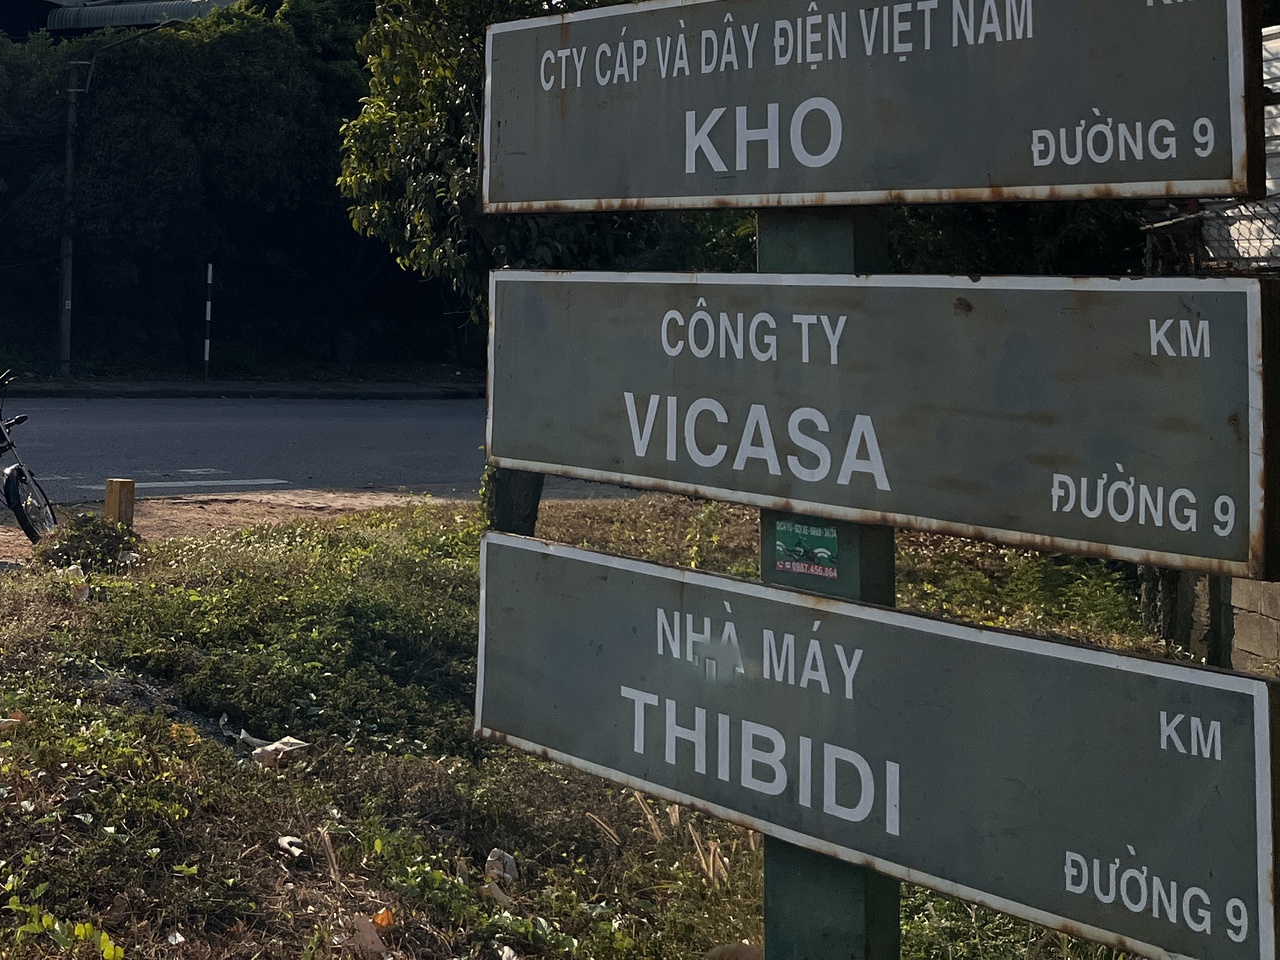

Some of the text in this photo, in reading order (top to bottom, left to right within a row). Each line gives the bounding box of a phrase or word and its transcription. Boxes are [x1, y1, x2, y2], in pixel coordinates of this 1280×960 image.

[540, 47, 586, 90] CTY
[596, 26, 647, 86] CÁP
[656, 19, 690, 78] VÀ
[701, 13, 760, 73] DÂY
[774, 2, 847, 70] ĐIỆN
[686, 97, 843, 174] KHO
[1032, 108, 1215, 167] ĐƯỜNG 9
[662, 298, 848, 365] CÔNG TY
[1149, 318, 1211, 358] KM
[623, 392, 892, 491] VICASA
[1051, 463, 1236, 537] ĐƯỜNG 9
[763, 620, 864, 700] MÁY
[620, 686, 901, 836] THIBIDI
[1159, 711, 1222, 761] KM
[1065, 844, 1249, 943] ĐƯỜNG 9
